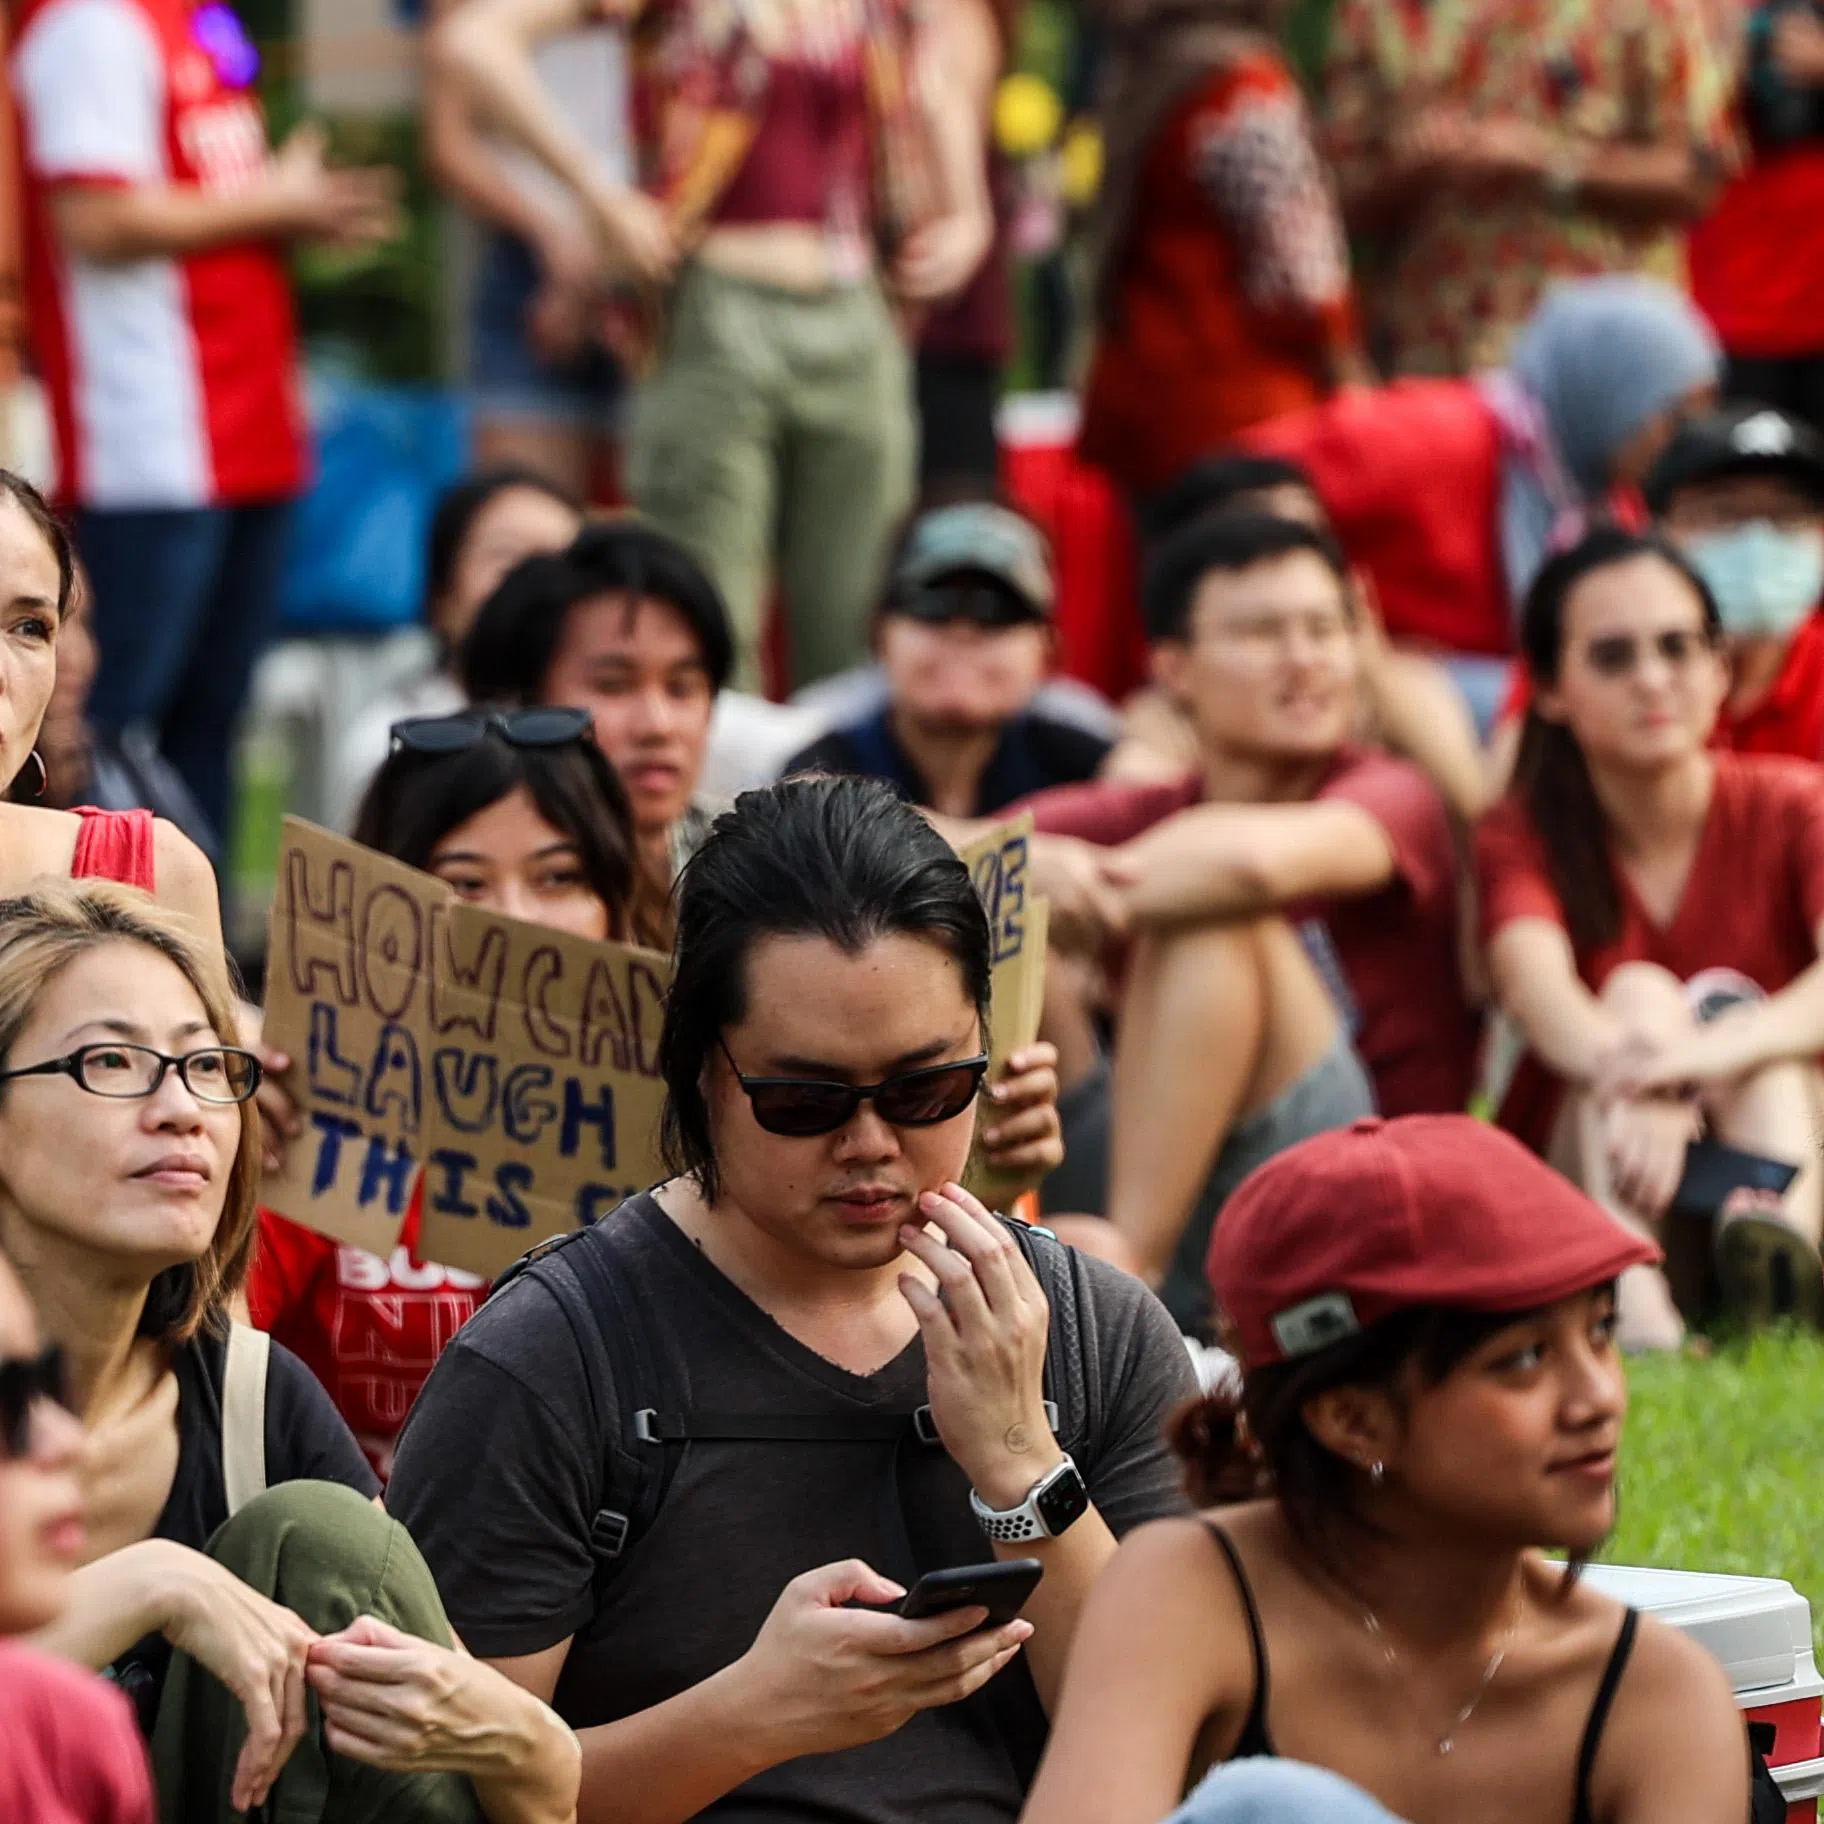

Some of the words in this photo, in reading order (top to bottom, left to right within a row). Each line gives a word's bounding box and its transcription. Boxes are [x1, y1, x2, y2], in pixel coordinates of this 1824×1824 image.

[288, 848, 507, 1042] HOW
[309, 1001, 617, 1171] LAUGH
[310, 1110, 534, 1230] THIS
